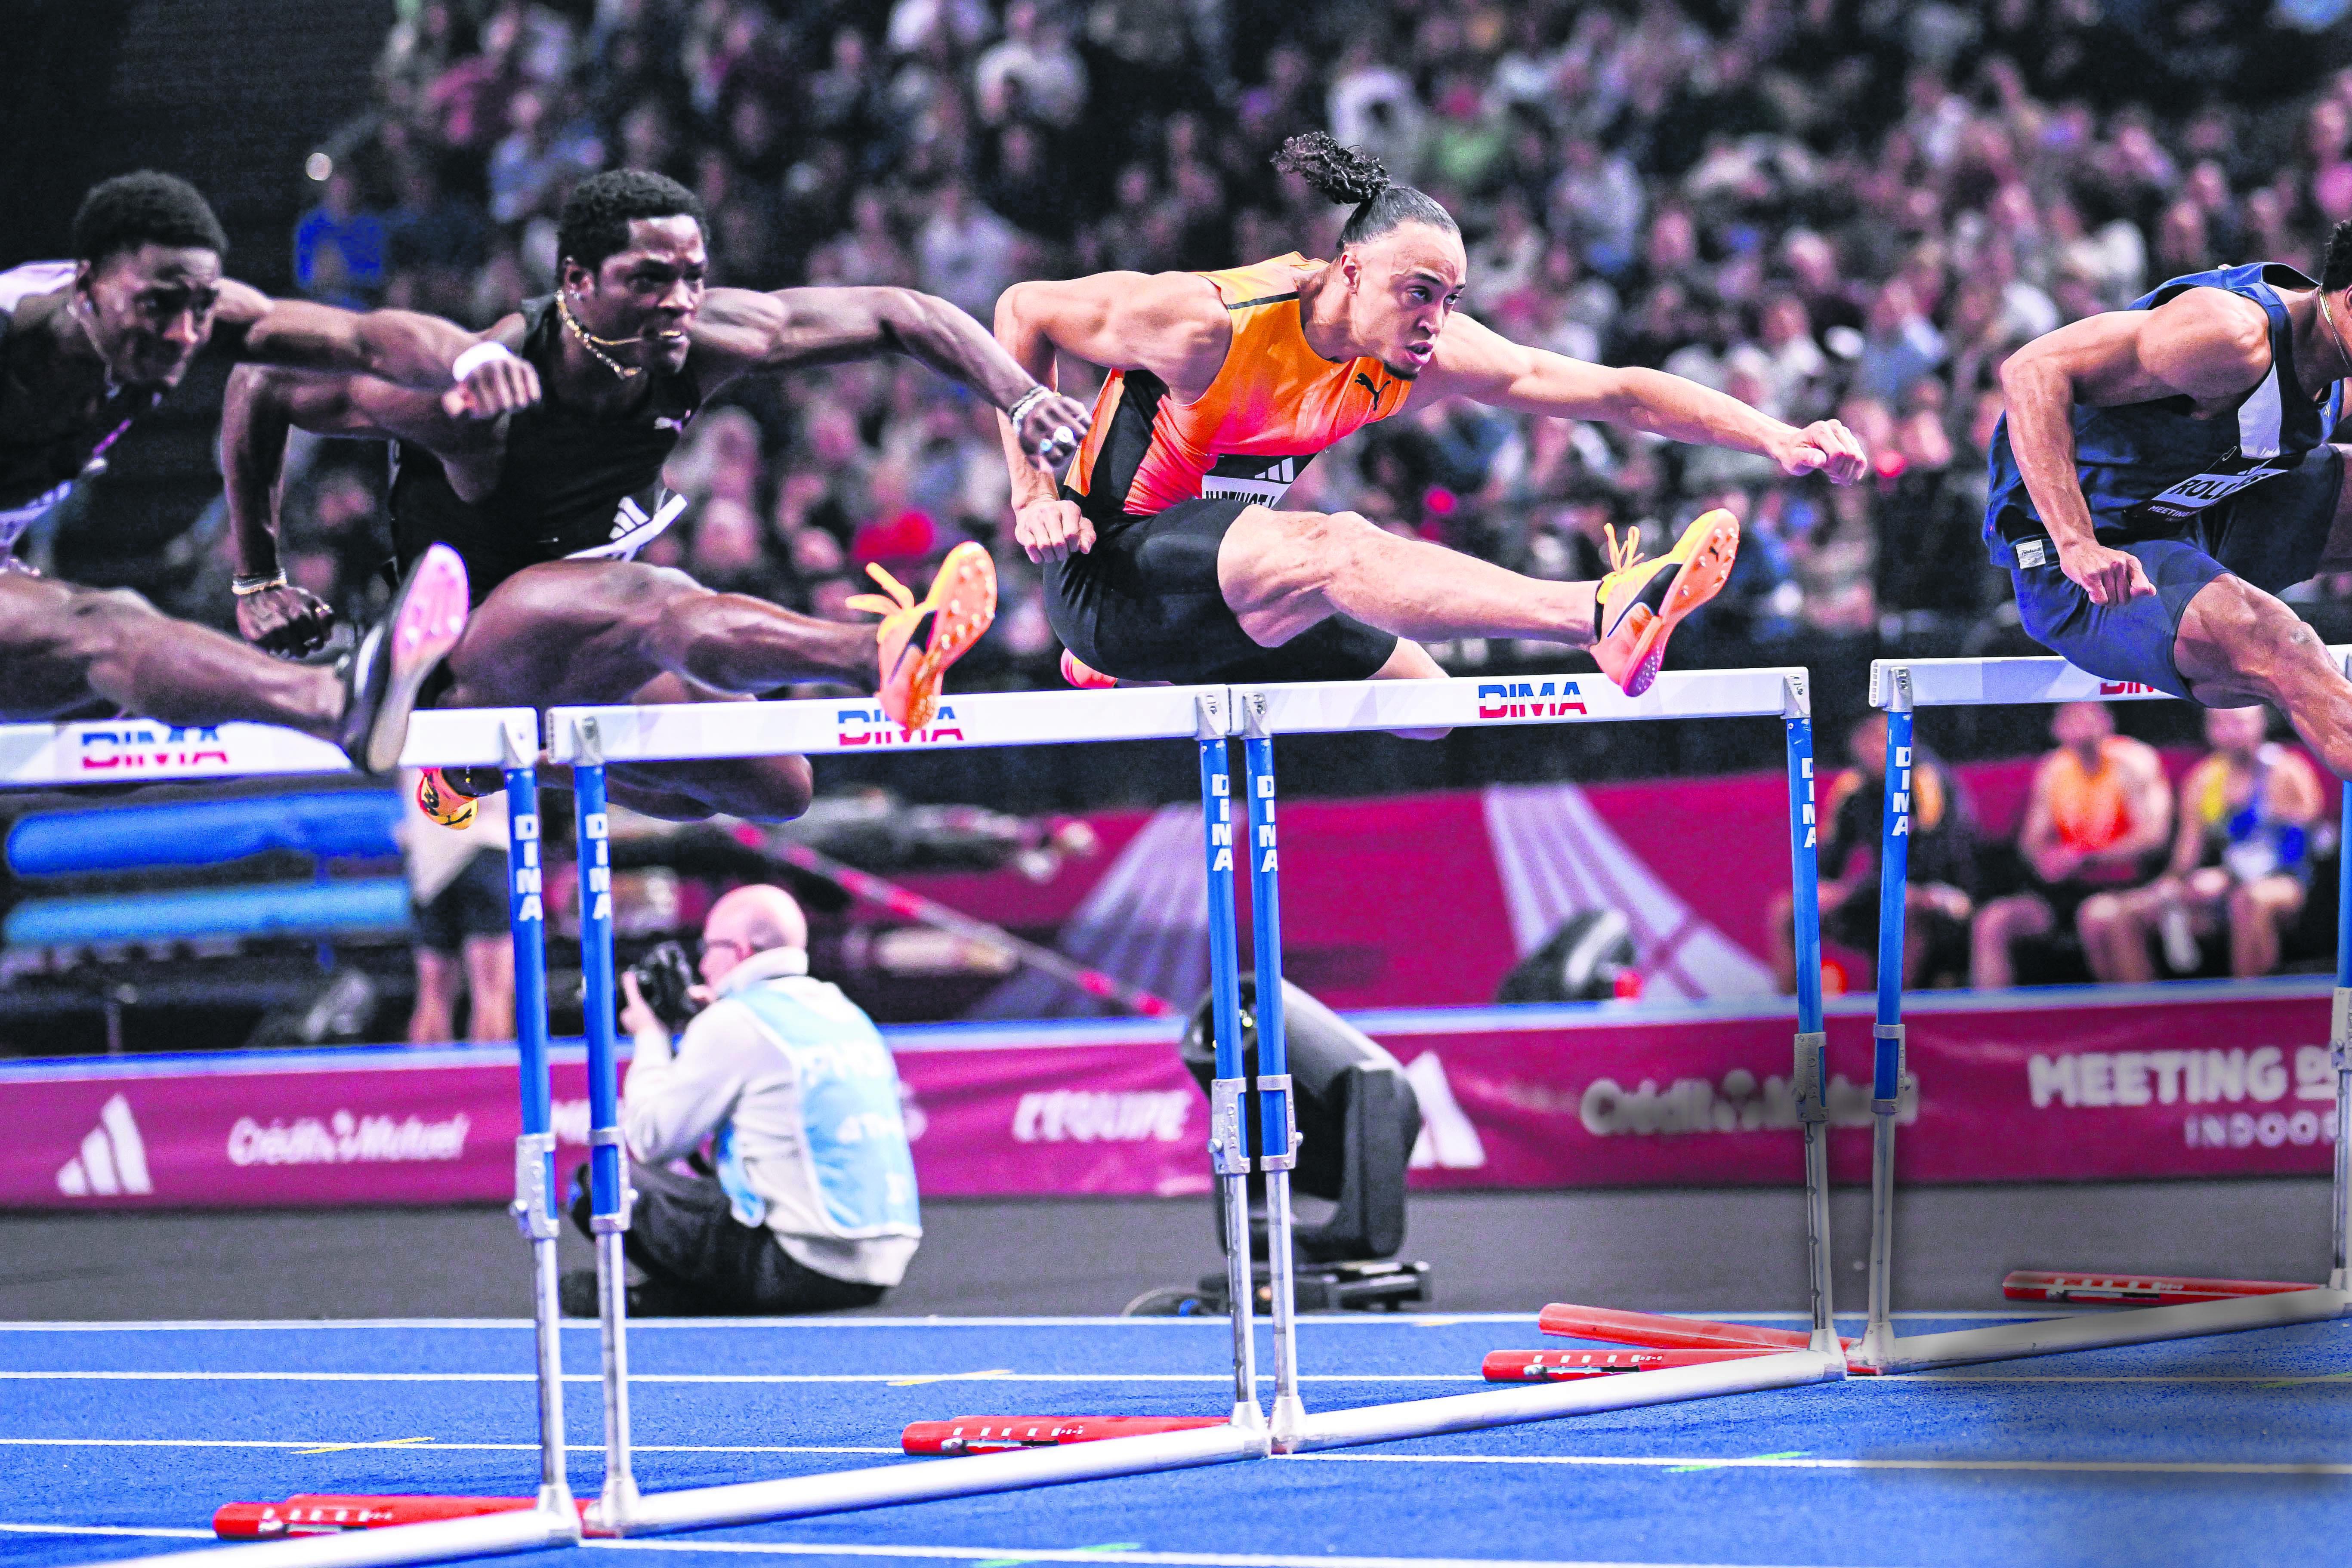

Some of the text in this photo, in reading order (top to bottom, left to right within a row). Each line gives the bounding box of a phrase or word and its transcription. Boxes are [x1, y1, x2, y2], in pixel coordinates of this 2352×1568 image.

[1478, 682, 1587, 719] DIMA
[82, 730, 227, 769] DIMA
[1892, 747, 1911, 836] DIMA
[514, 815, 543, 921] DIMA
[586, 813, 612, 920] DIMA
[1212, 774, 1233, 871] DIMA
[1257, 775, 1278, 872] DIMA
[2028, 1047, 2287, 1108] MEETING
